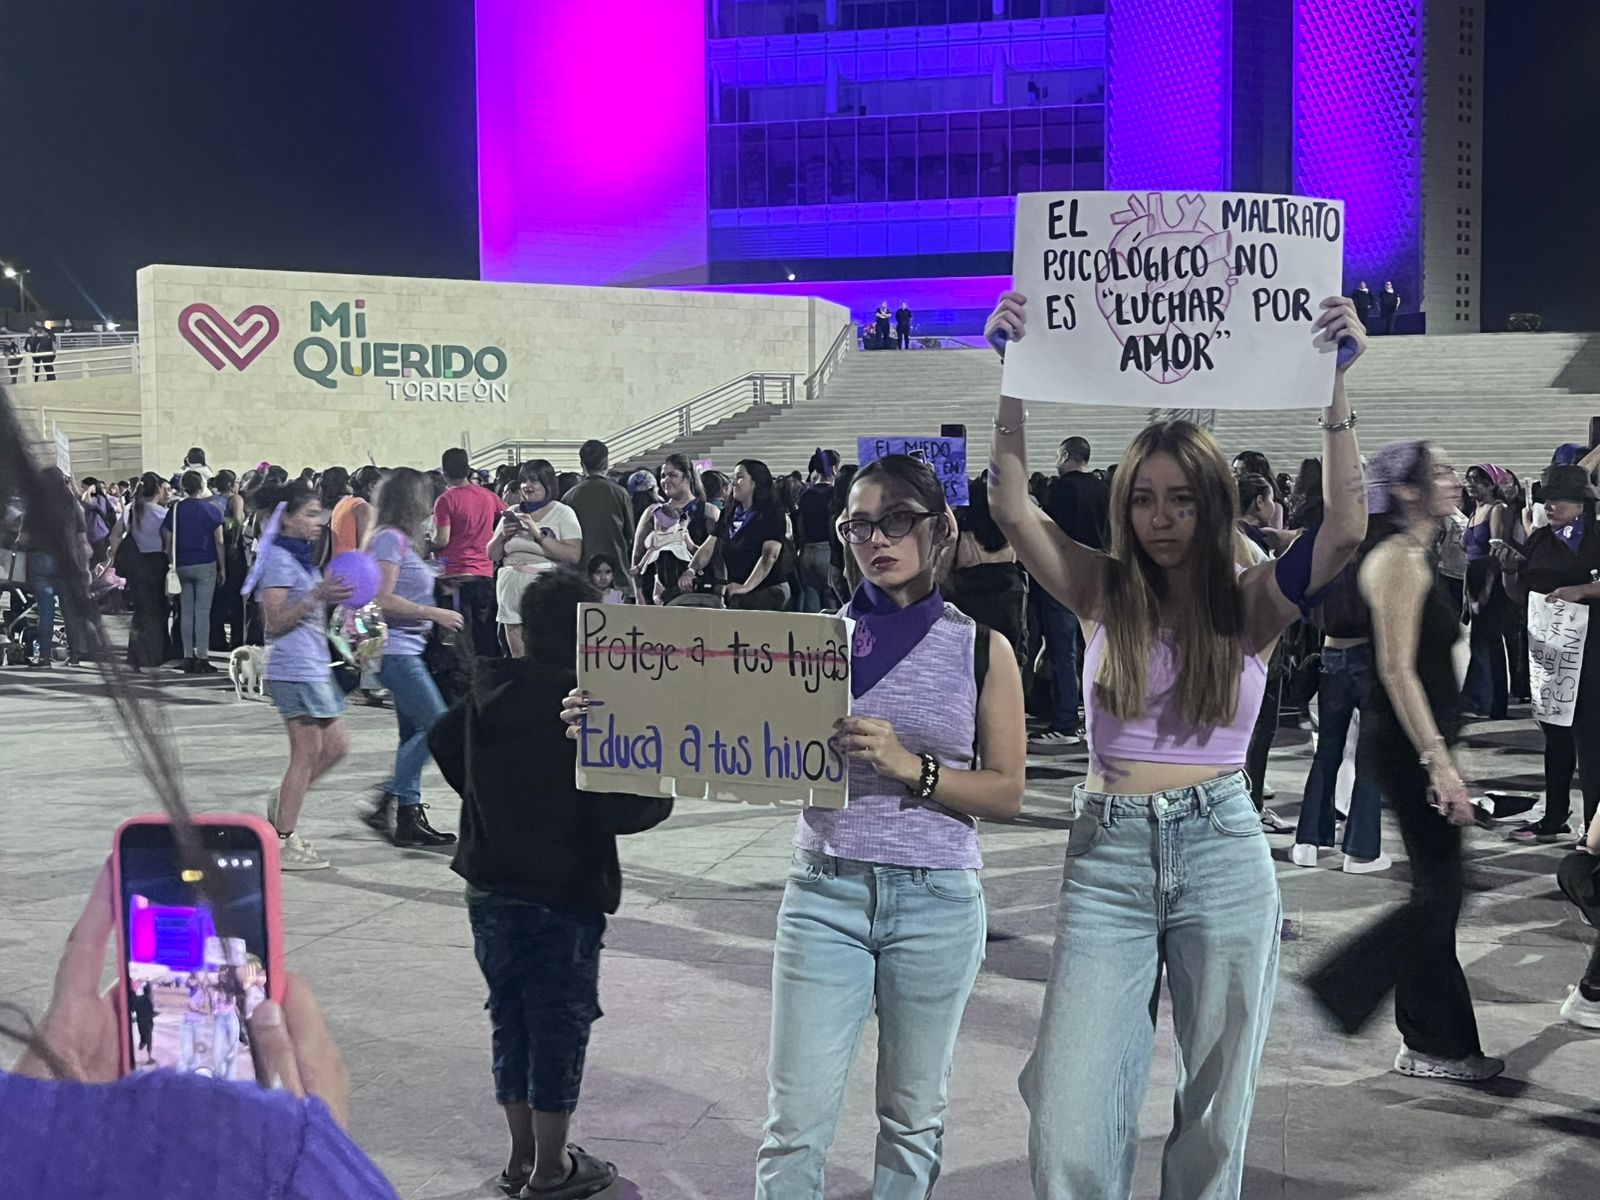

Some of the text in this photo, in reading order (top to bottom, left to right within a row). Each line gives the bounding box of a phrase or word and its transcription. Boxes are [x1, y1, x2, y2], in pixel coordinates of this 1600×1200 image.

[1048, 198, 1341, 243] EL MALTRATO
[1043, 231, 1278, 284] PSICOLÓGICO NO
[310, 299, 367, 339] Mi
[1046, 293, 1077, 331] ES
[1252, 287, 1313, 323] POR
[293, 336, 508, 390] QUERIDO
[584, 608, 848, 693] Protege a tus hijas
[581, 701, 844, 783] Educa a tus hijos
